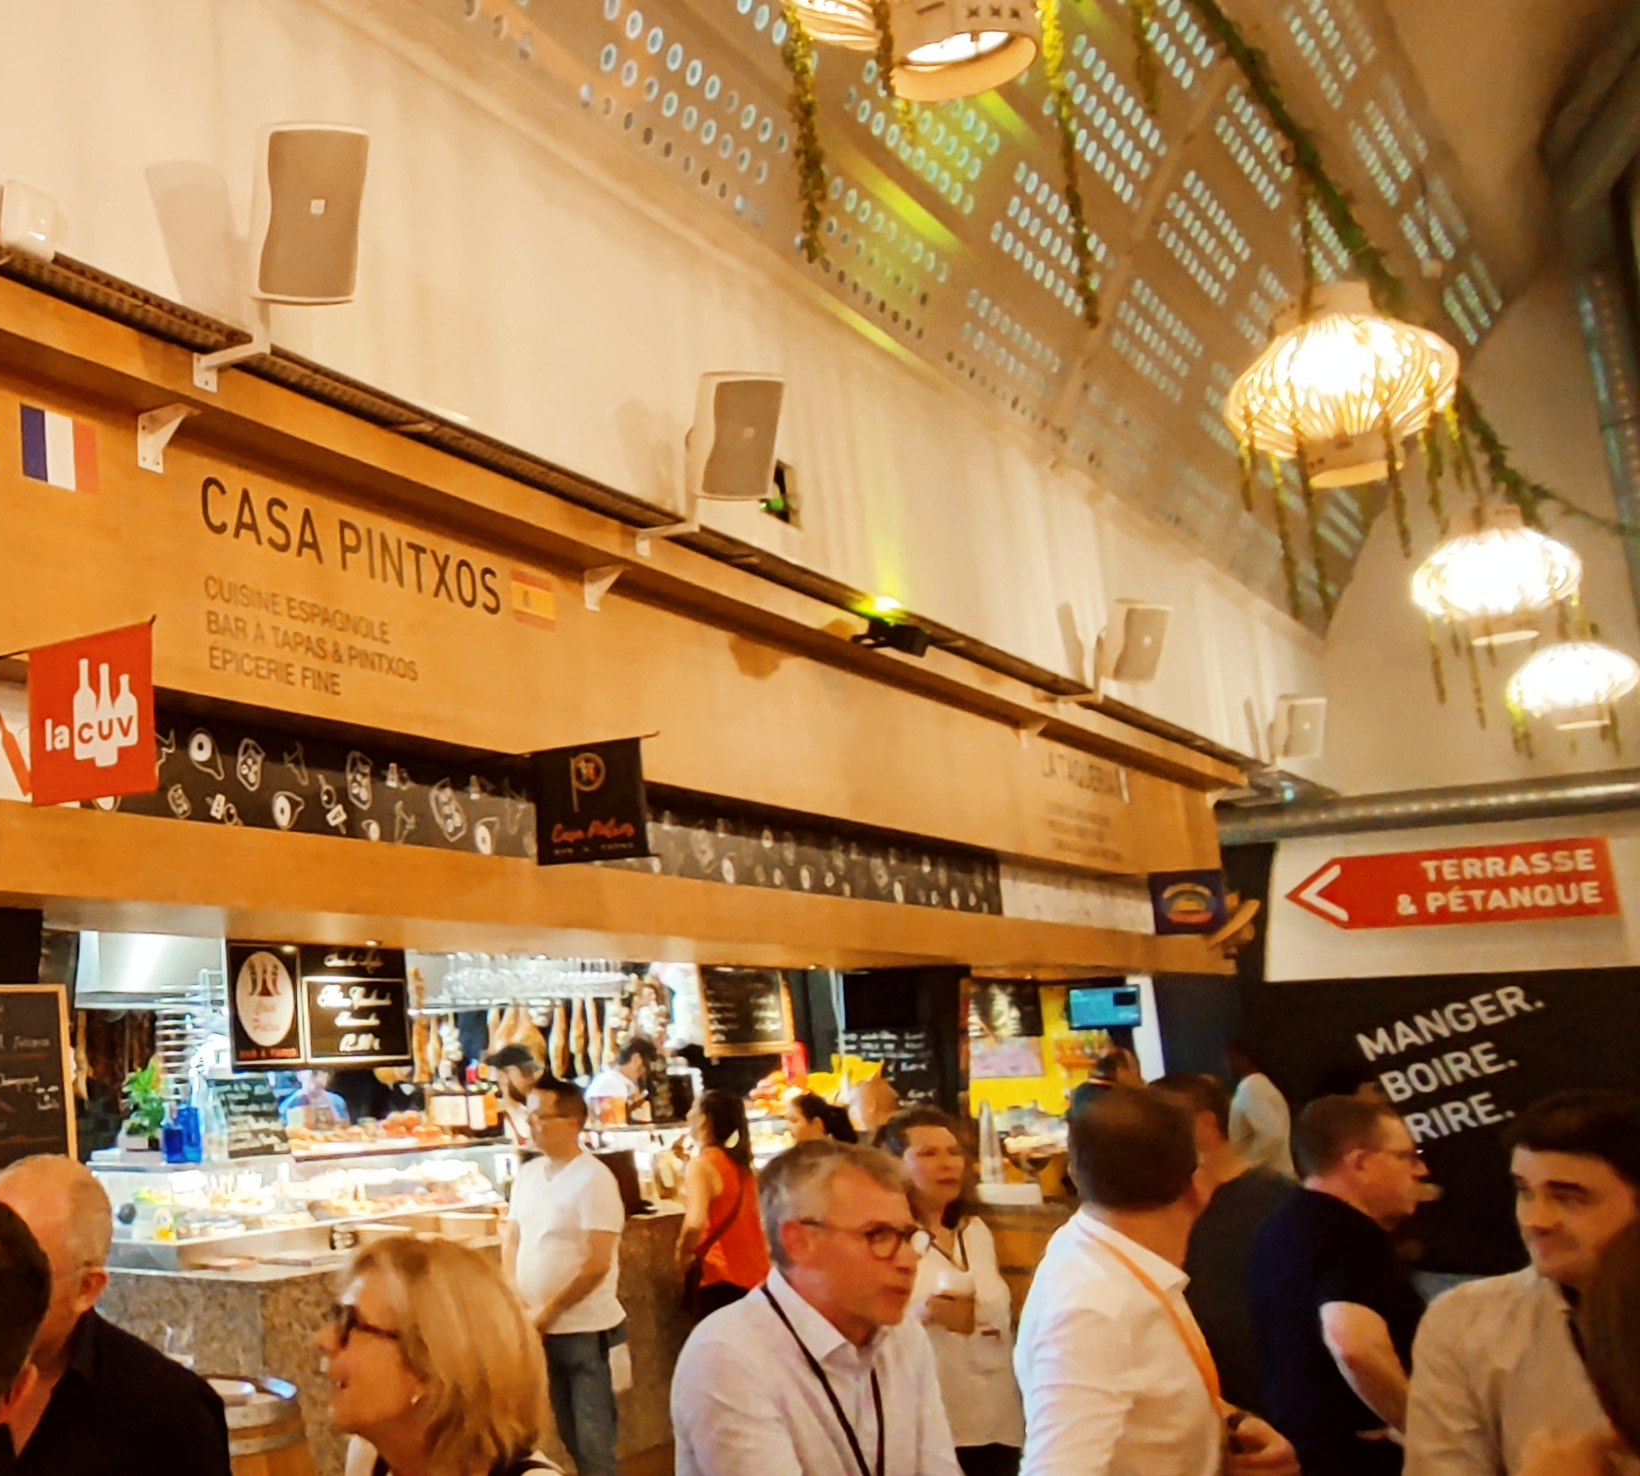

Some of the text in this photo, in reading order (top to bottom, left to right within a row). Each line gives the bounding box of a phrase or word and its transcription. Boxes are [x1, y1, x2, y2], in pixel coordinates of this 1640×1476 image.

[201, 475, 502, 616] CASA PINTXOS
[204, 575, 392, 645] CUISINE ESPAGNOLE
[206, 610, 248, 640] BAR
[270, 625, 328, 660] TAPAS
[331, 640, 344, 664] &
[347, 645, 420, 682] PINTXOS
[209, 639, 342, 696] ÉPICERIE FINE
[45, 714, 135, 752] la CUV
[1421, 849, 1597, 882] TERRASSE
[1396, 880, 1603, 916] & PÉTANQUE
[1355, 985, 1546, 1063] MANGER.
[1379, 1041, 1520, 1103] BOIRE.
[1403, 1091, 1516, 1143] RIRE.
